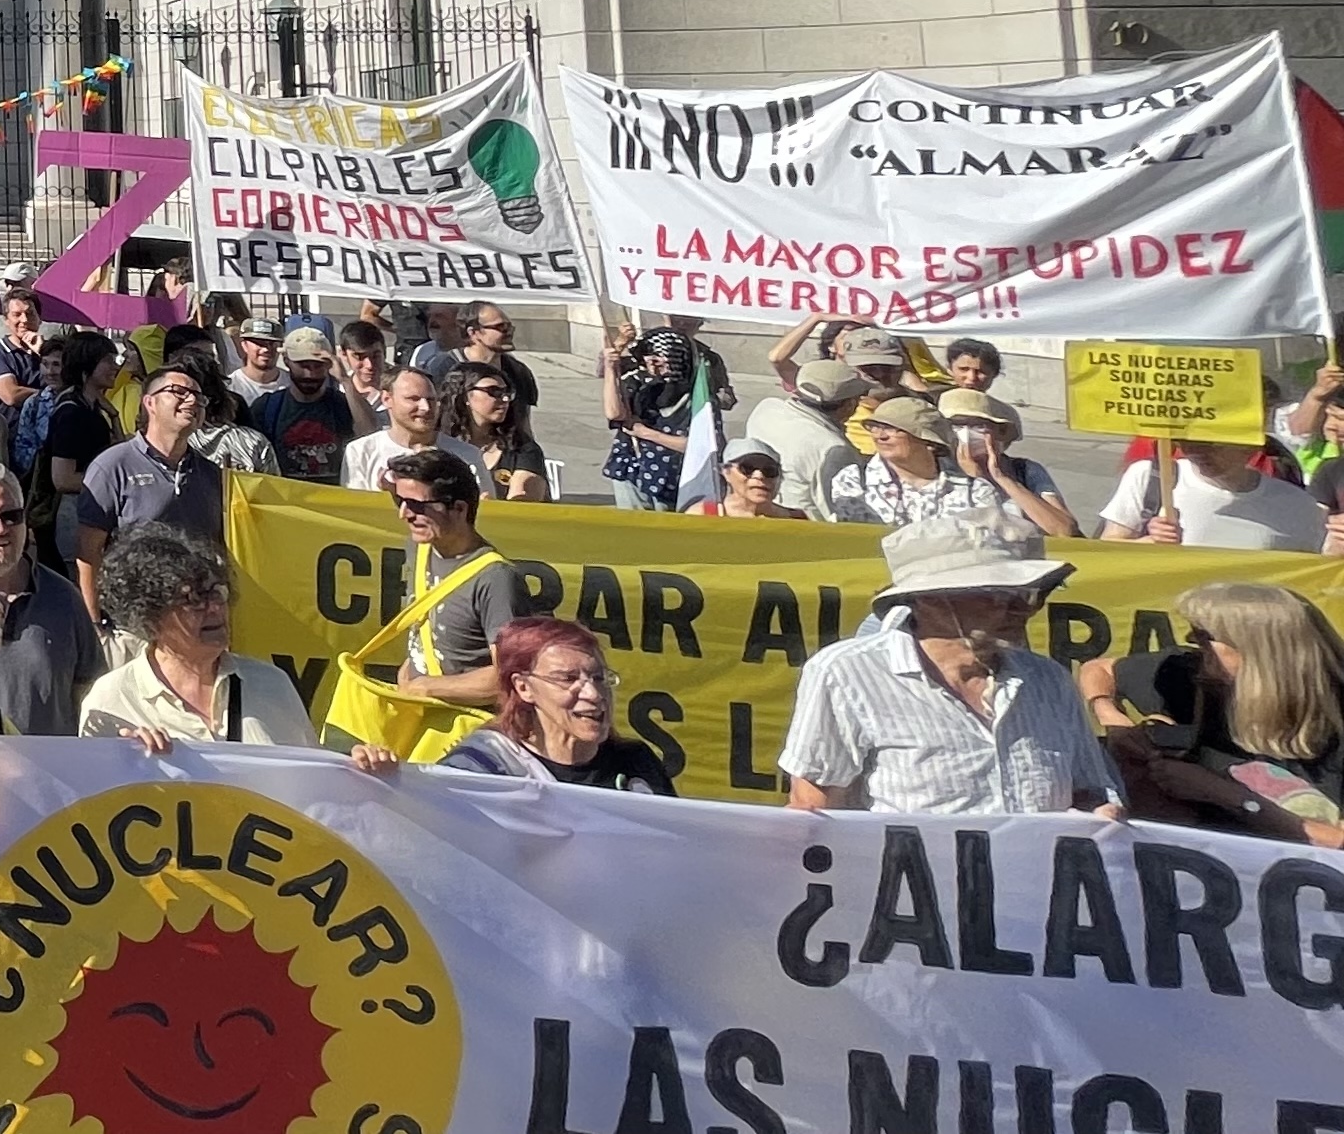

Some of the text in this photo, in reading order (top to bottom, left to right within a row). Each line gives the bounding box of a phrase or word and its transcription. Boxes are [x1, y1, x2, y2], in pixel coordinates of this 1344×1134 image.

[849, 82, 1214, 126] CONTINUAR
[208, 136, 464, 194] CULPABLES
[212, 187, 467, 242] GOBIERNOS
[217, 237, 584, 291] RESPONSABLES
[656, 223, 713, 261] LA
[722, 228, 904, 281] MAYOR
[922, 228, 1256, 285] ESTUPIDEZ
[620, 267, 644, 298] Y
[660, 267, 960, 326] TEMERIDAD
[1088, 352, 1235, 373] LAS NUCLEARES
[1109, 370, 1215, 388] SON CARAS
[1104, 401, 1216, 421] PELIGROSAS
[1120, 386, 1206, 404] SUCIAS Y
[526, 1018, 786, 1134] LAS
